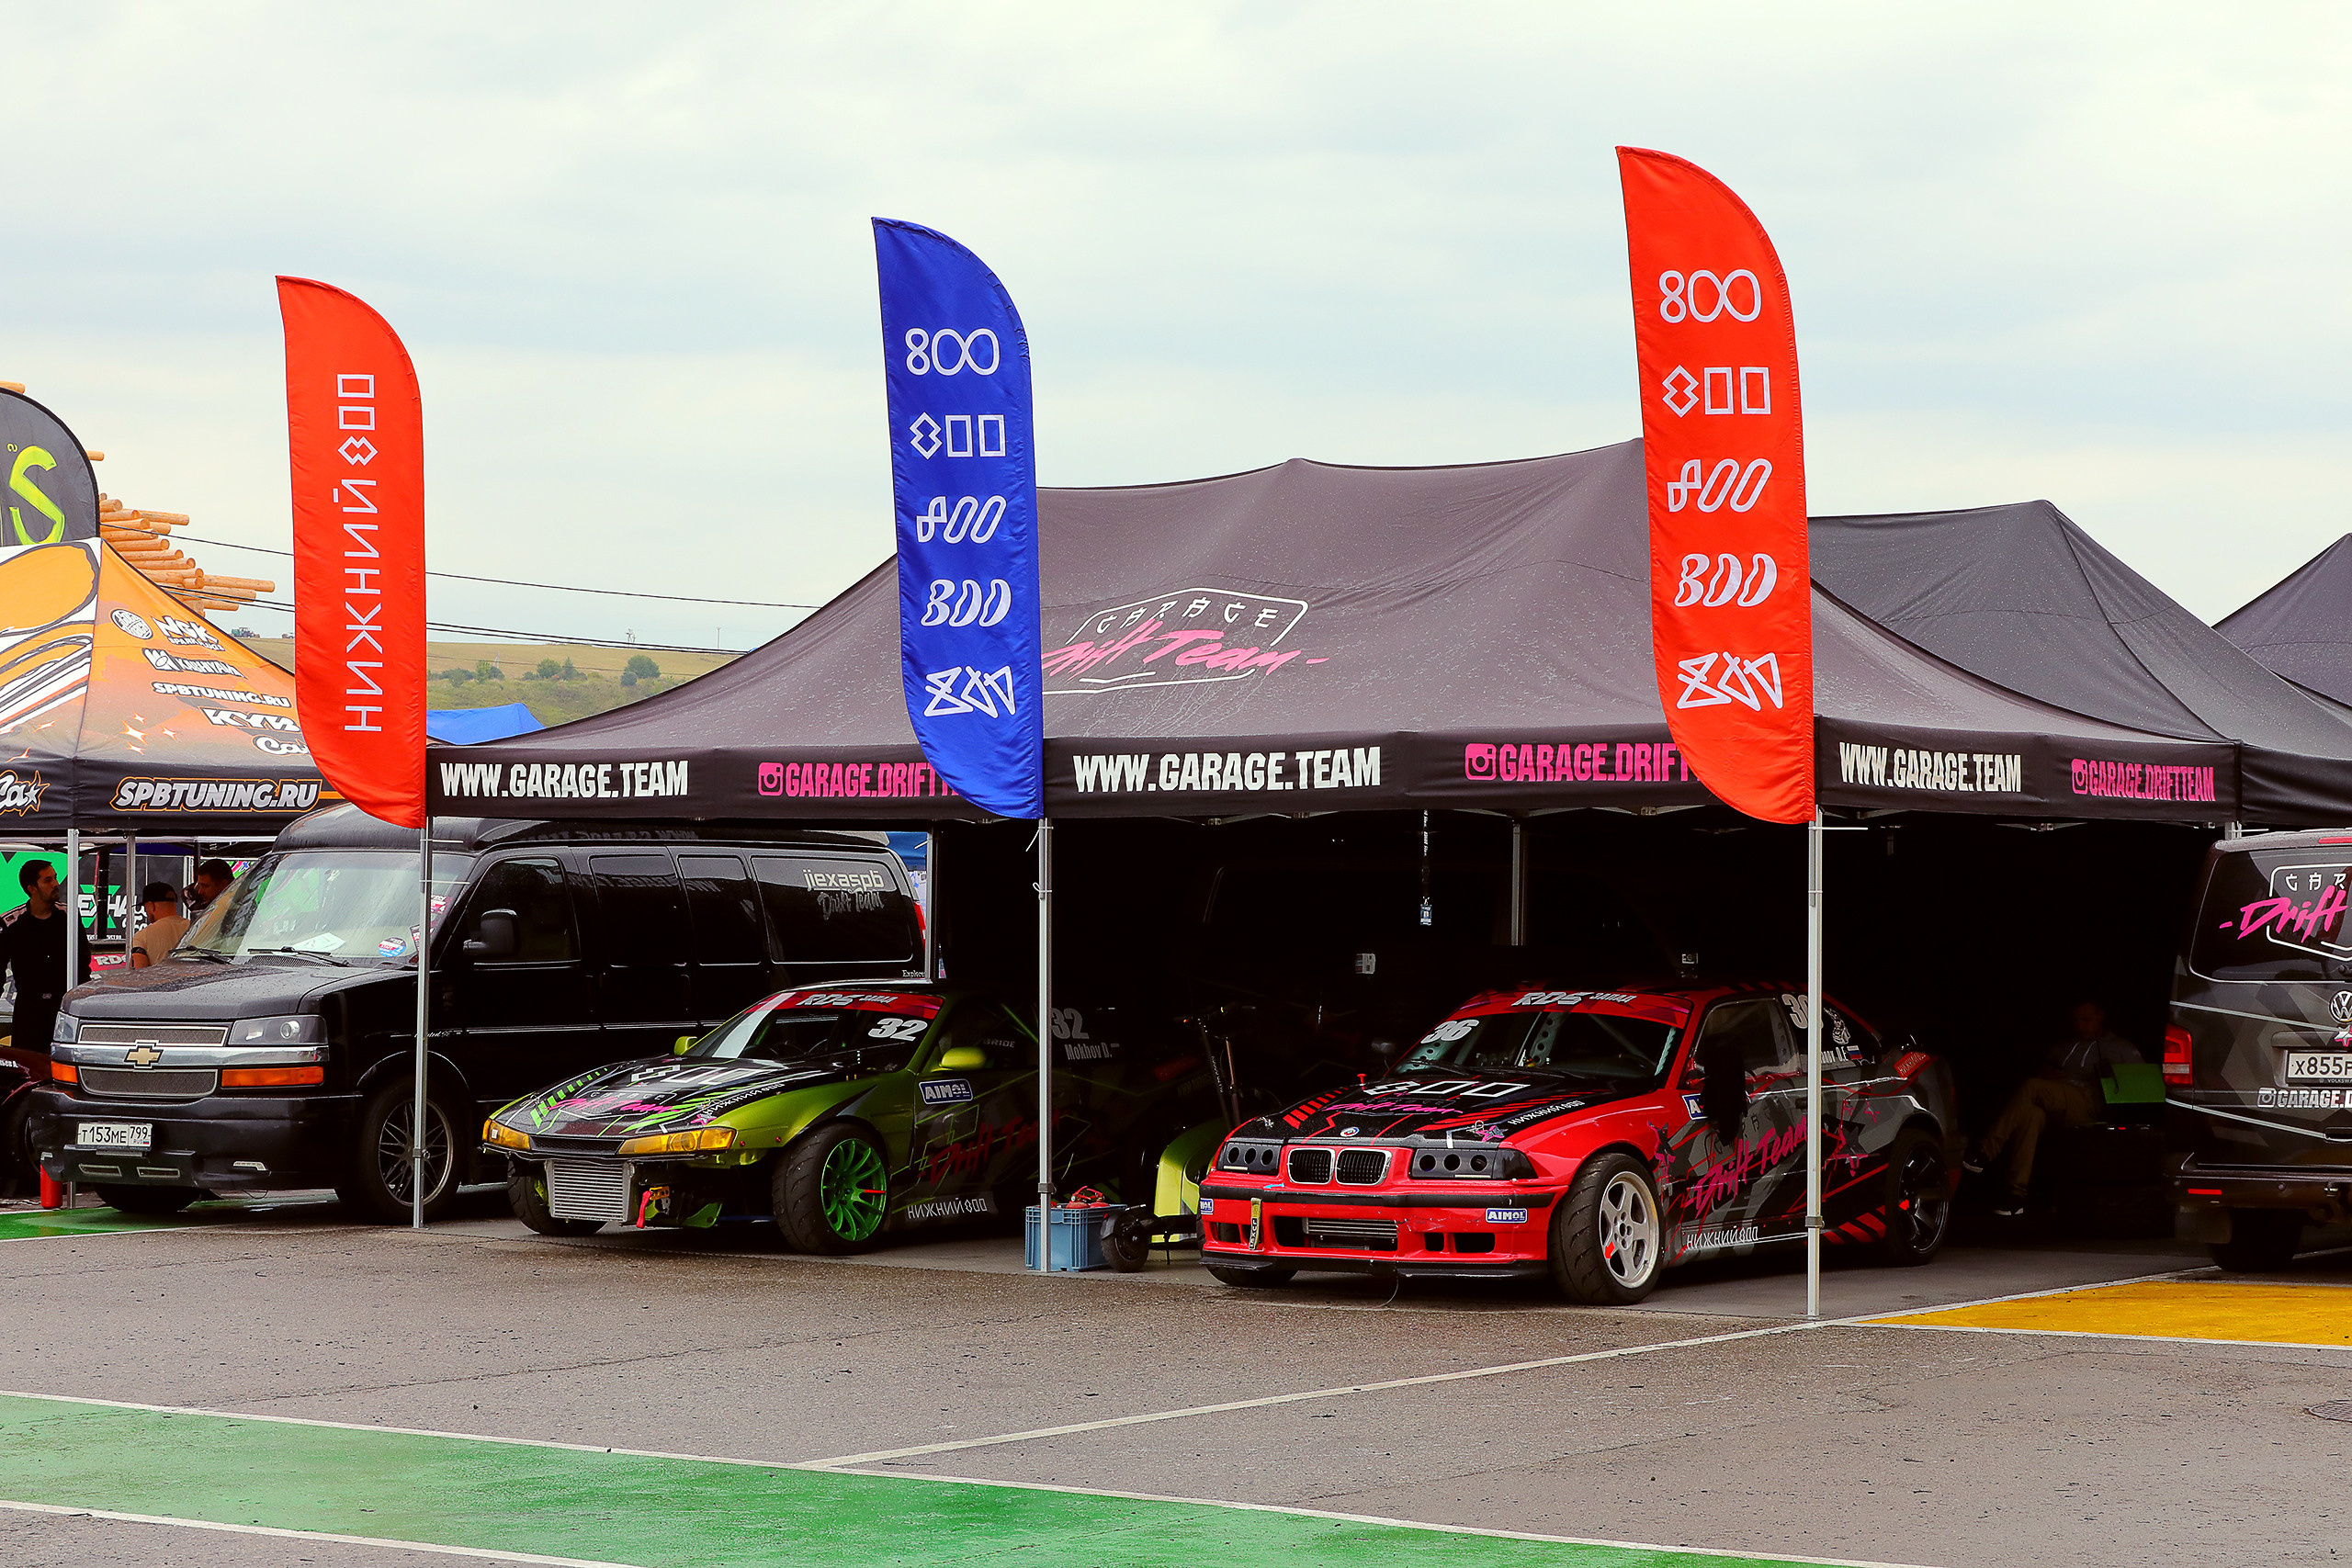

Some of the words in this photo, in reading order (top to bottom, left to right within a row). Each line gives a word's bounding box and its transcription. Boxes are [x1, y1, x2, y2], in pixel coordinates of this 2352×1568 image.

[1658, 268, 1762, 323] 800
[905, 328, 1001, 376] 800
[1662, 364, 1772, 418] 800
[909, 412, 1006, 459] 800
[1097, 597, 1279, 633] GARAGE
[1142, 629, 1302, 676] Team
[152, 682, 291, 708] SPBTUNING.RU
[440, 760, 689, 798] WWW.GARAGE.TEAM
[1072, 746, 1381, 793] WWW.GARAGE.TEAM
[1839, 741, 2021, 793] WWW.GARAGE.TEAM
[2088, 761, 2216, 802] GARAGE.DRIFTTEAM
[115, 781, 320, 808] SPBTUNING.RU
[2237, 885, 2348, 943] Drift
[797, 993, 865, 1007] RDS
[1511, 992, 1594, 1006] RDS
[868, 1018, 928, 1042] 32
[1051, 1007, 1090, 1040] 32
[1420, 1019, 1479, 1043] 36
[923, 1082, 971, 1100] AIMOL
[130, 1125, 148, 1139] 799
[1693, 1138, 1755, 1220] Drift
[1487, 1211, 1525, 1221] AIMOL
